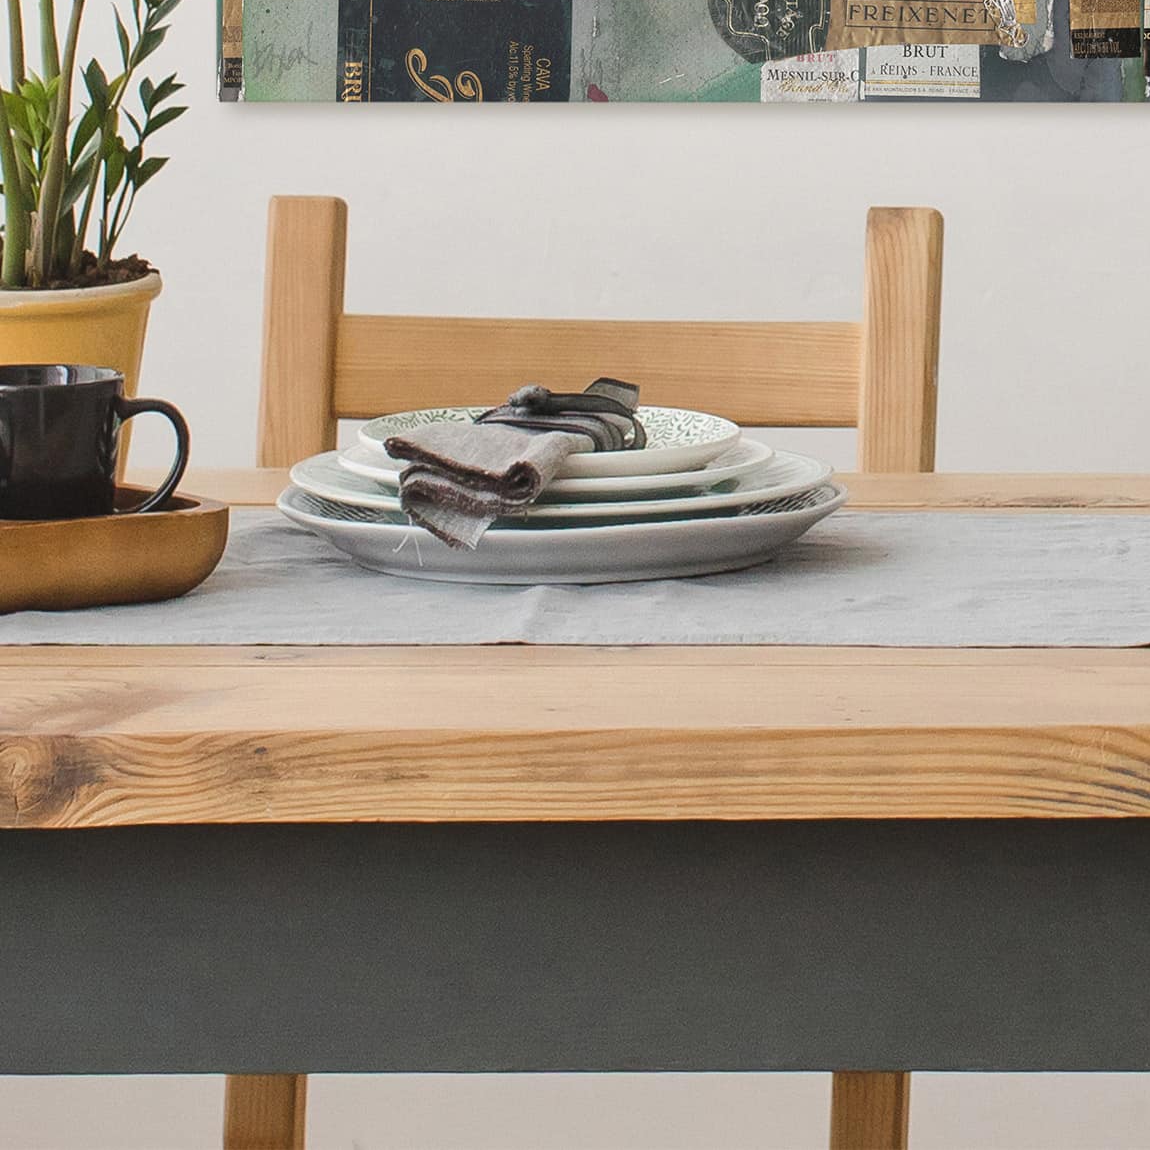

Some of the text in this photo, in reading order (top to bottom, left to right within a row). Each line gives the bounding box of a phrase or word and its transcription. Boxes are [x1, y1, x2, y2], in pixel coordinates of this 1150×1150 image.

[849, 4, 990, 24] FREIXENET
[796, 53, 833, 63] BRUT
[903, 43, 949, 59] BRUT
[521, 45, 534, 82] Sparkling
[880, 64, 918, 76] REIMS
[929, 65, 979, 78] FRANCE
[536, 58, 552, 91] CAVA
